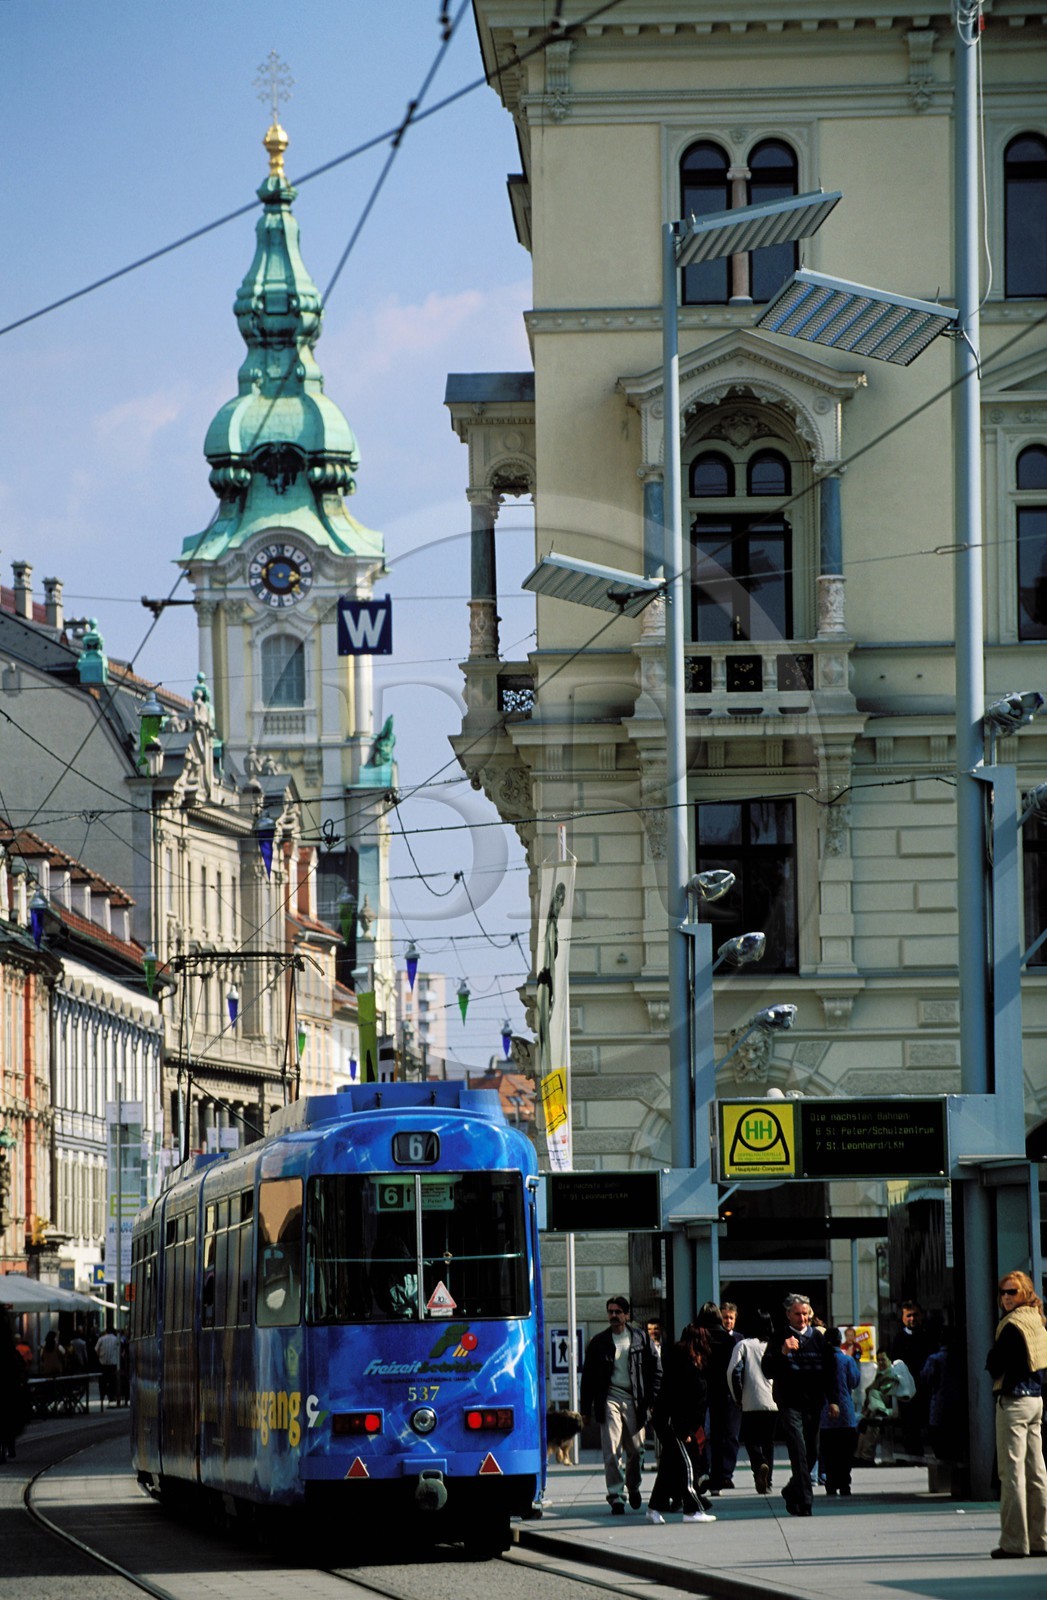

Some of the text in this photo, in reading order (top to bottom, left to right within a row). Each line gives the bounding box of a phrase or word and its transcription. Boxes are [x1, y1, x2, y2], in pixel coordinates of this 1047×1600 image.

[342, 608, 387, 649] W
[810, 1112, 826, 1121] Die
[745, 1120, 773, 1140] HH
[409, 1133, 423, 1161] 6
[815, 1141, 822, 1150] 7
[841, 1140, 905, 1150] Leonhard/LKH
[384, 1186, 399, 1205] 6
[407, 1386, 440, 1402] 537
